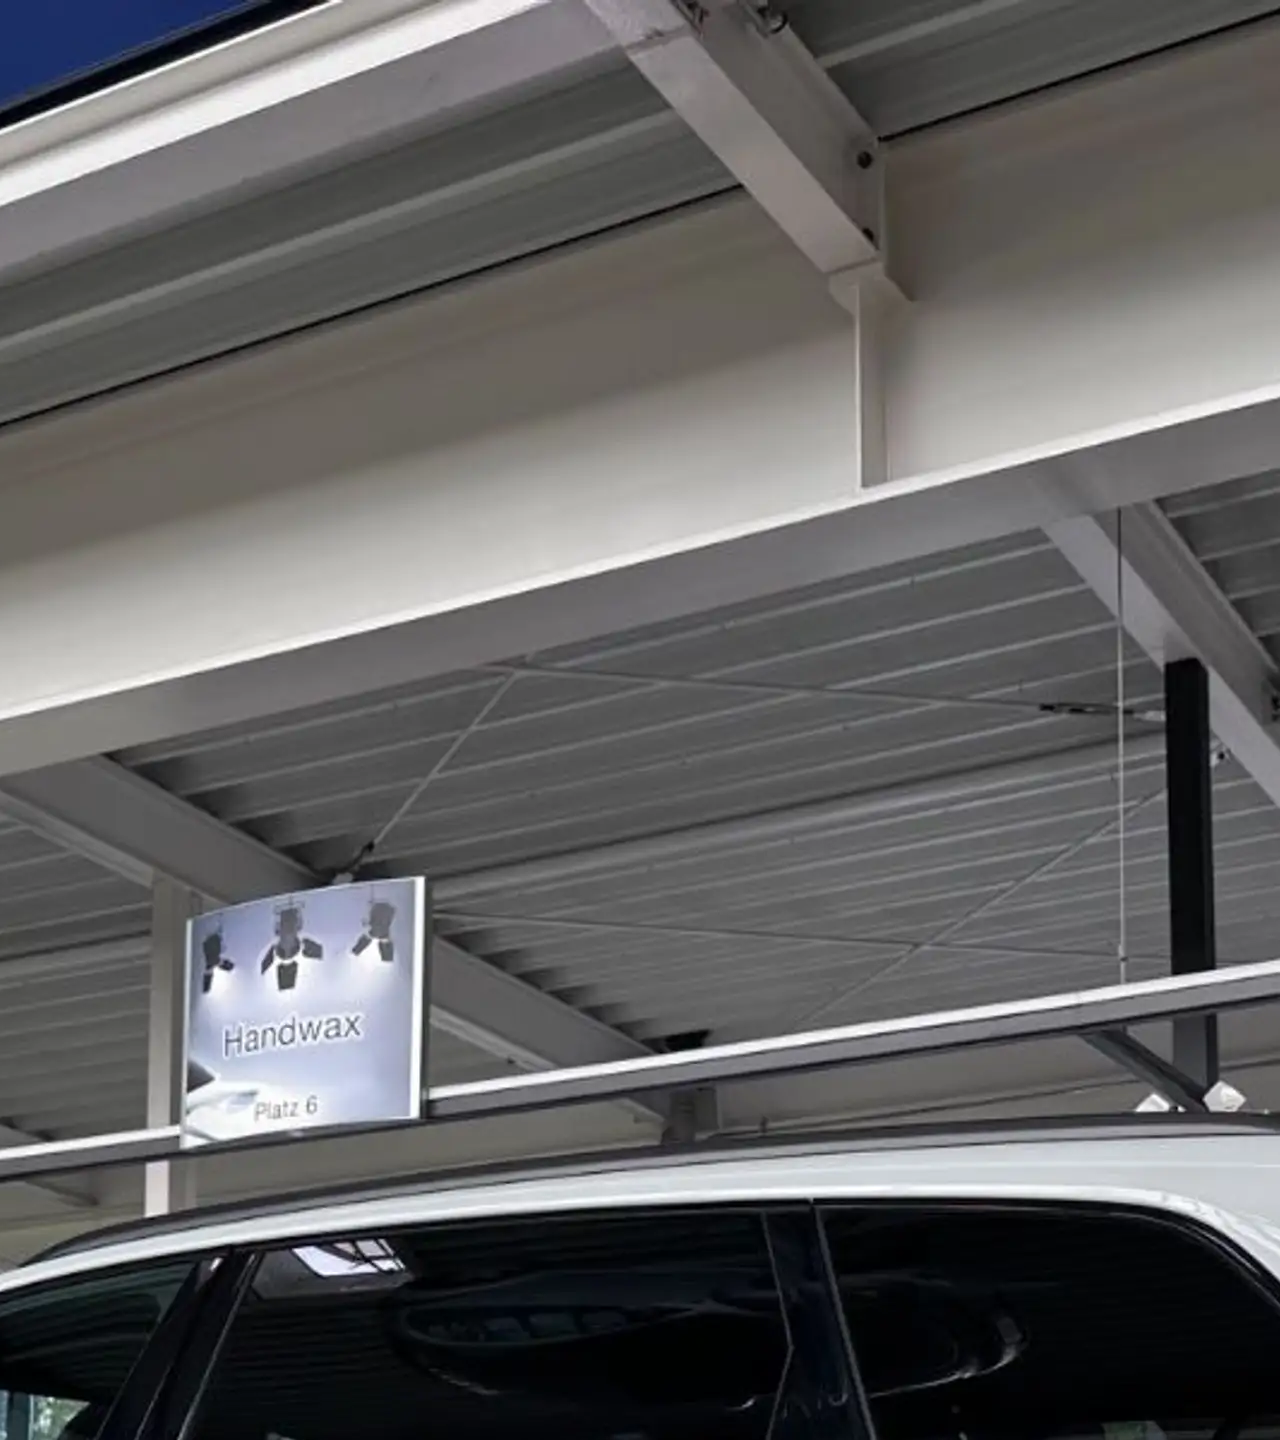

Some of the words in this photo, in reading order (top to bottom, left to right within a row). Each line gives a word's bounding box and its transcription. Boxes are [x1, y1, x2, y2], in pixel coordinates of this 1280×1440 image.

[223, 1014, 362, 1056] Handwax
[253, 1100, 299, 1121] Platz
[306, 1096, 319, 1115] 6
